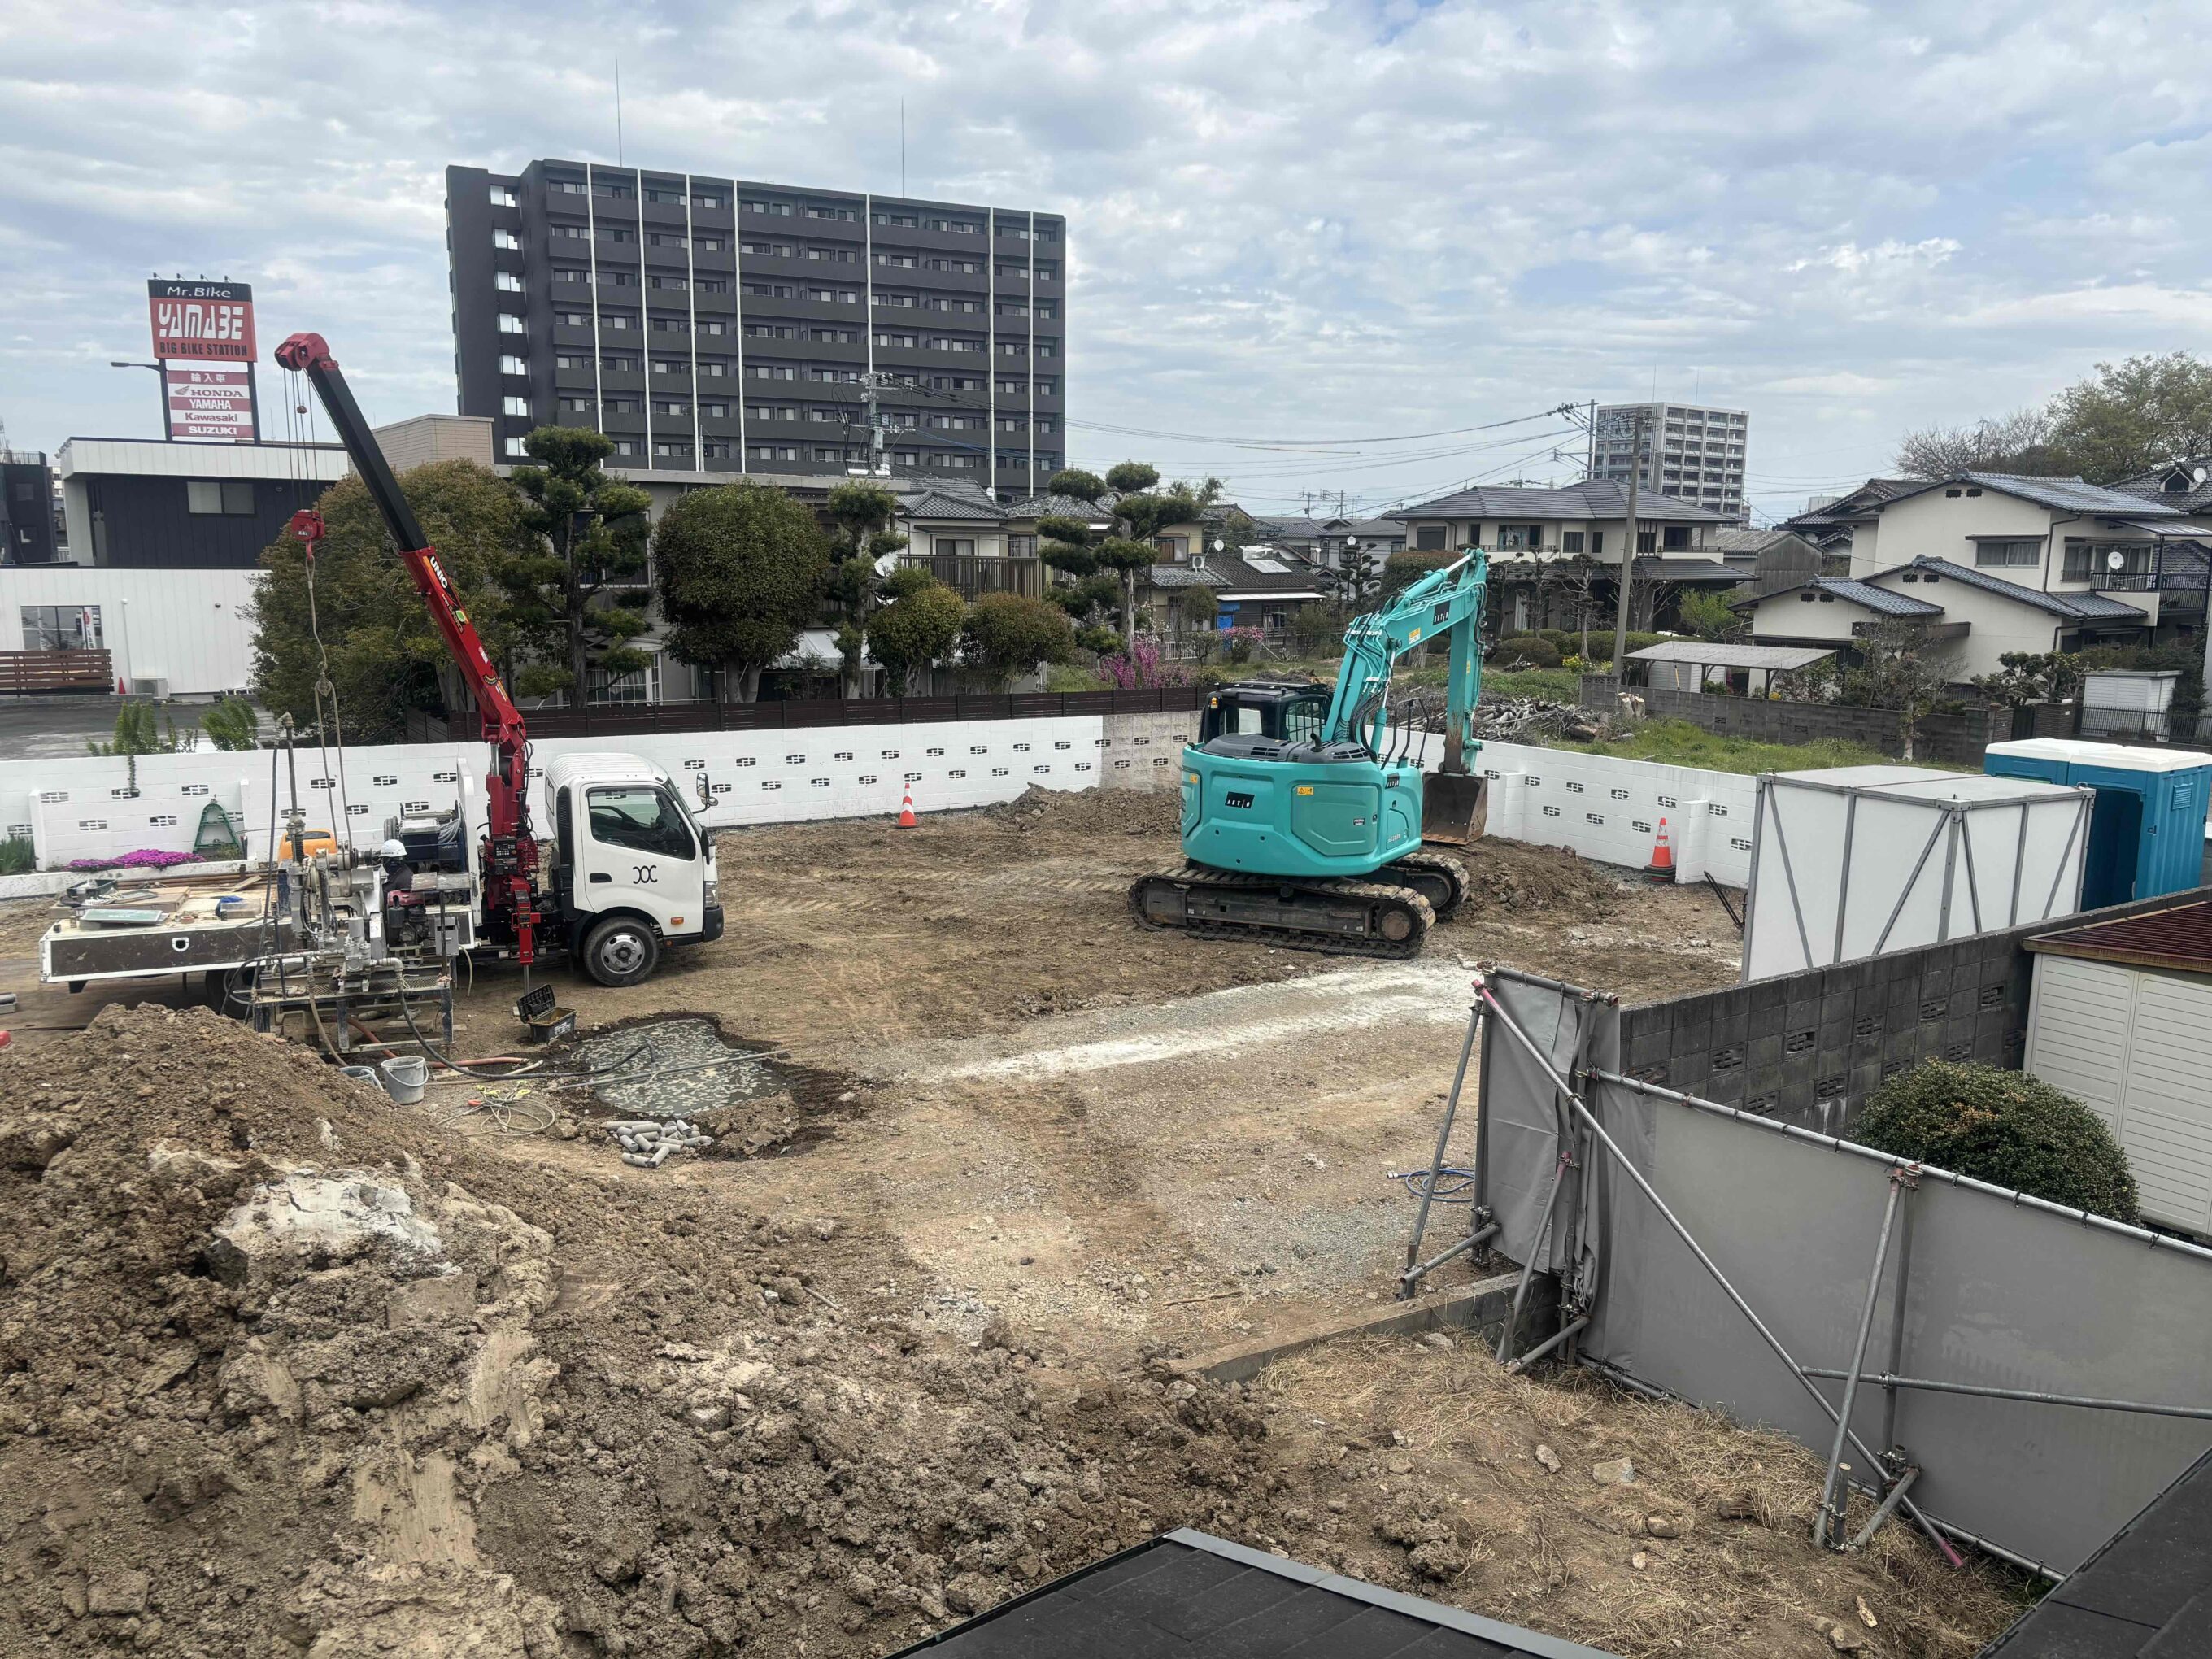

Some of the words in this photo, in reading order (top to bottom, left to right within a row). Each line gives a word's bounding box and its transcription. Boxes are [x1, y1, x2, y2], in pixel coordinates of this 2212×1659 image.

[167, 286, 232, 298] Mr.Bike
[158, 303, 244, 340] YAMABE
[159, 342, 177, 354] BIG
[181, 342, 203, 355] BIKE
[207, 343, 248, 356] STATION
[190, 390, 244, 398] HONDA
[189, 398, 232, 410] YAMAHA
[185, 412, 238, 422] Kawasaki
[188, 425, 237, 435] SUZUKI
[430, 555, 447, 589] UNIC
